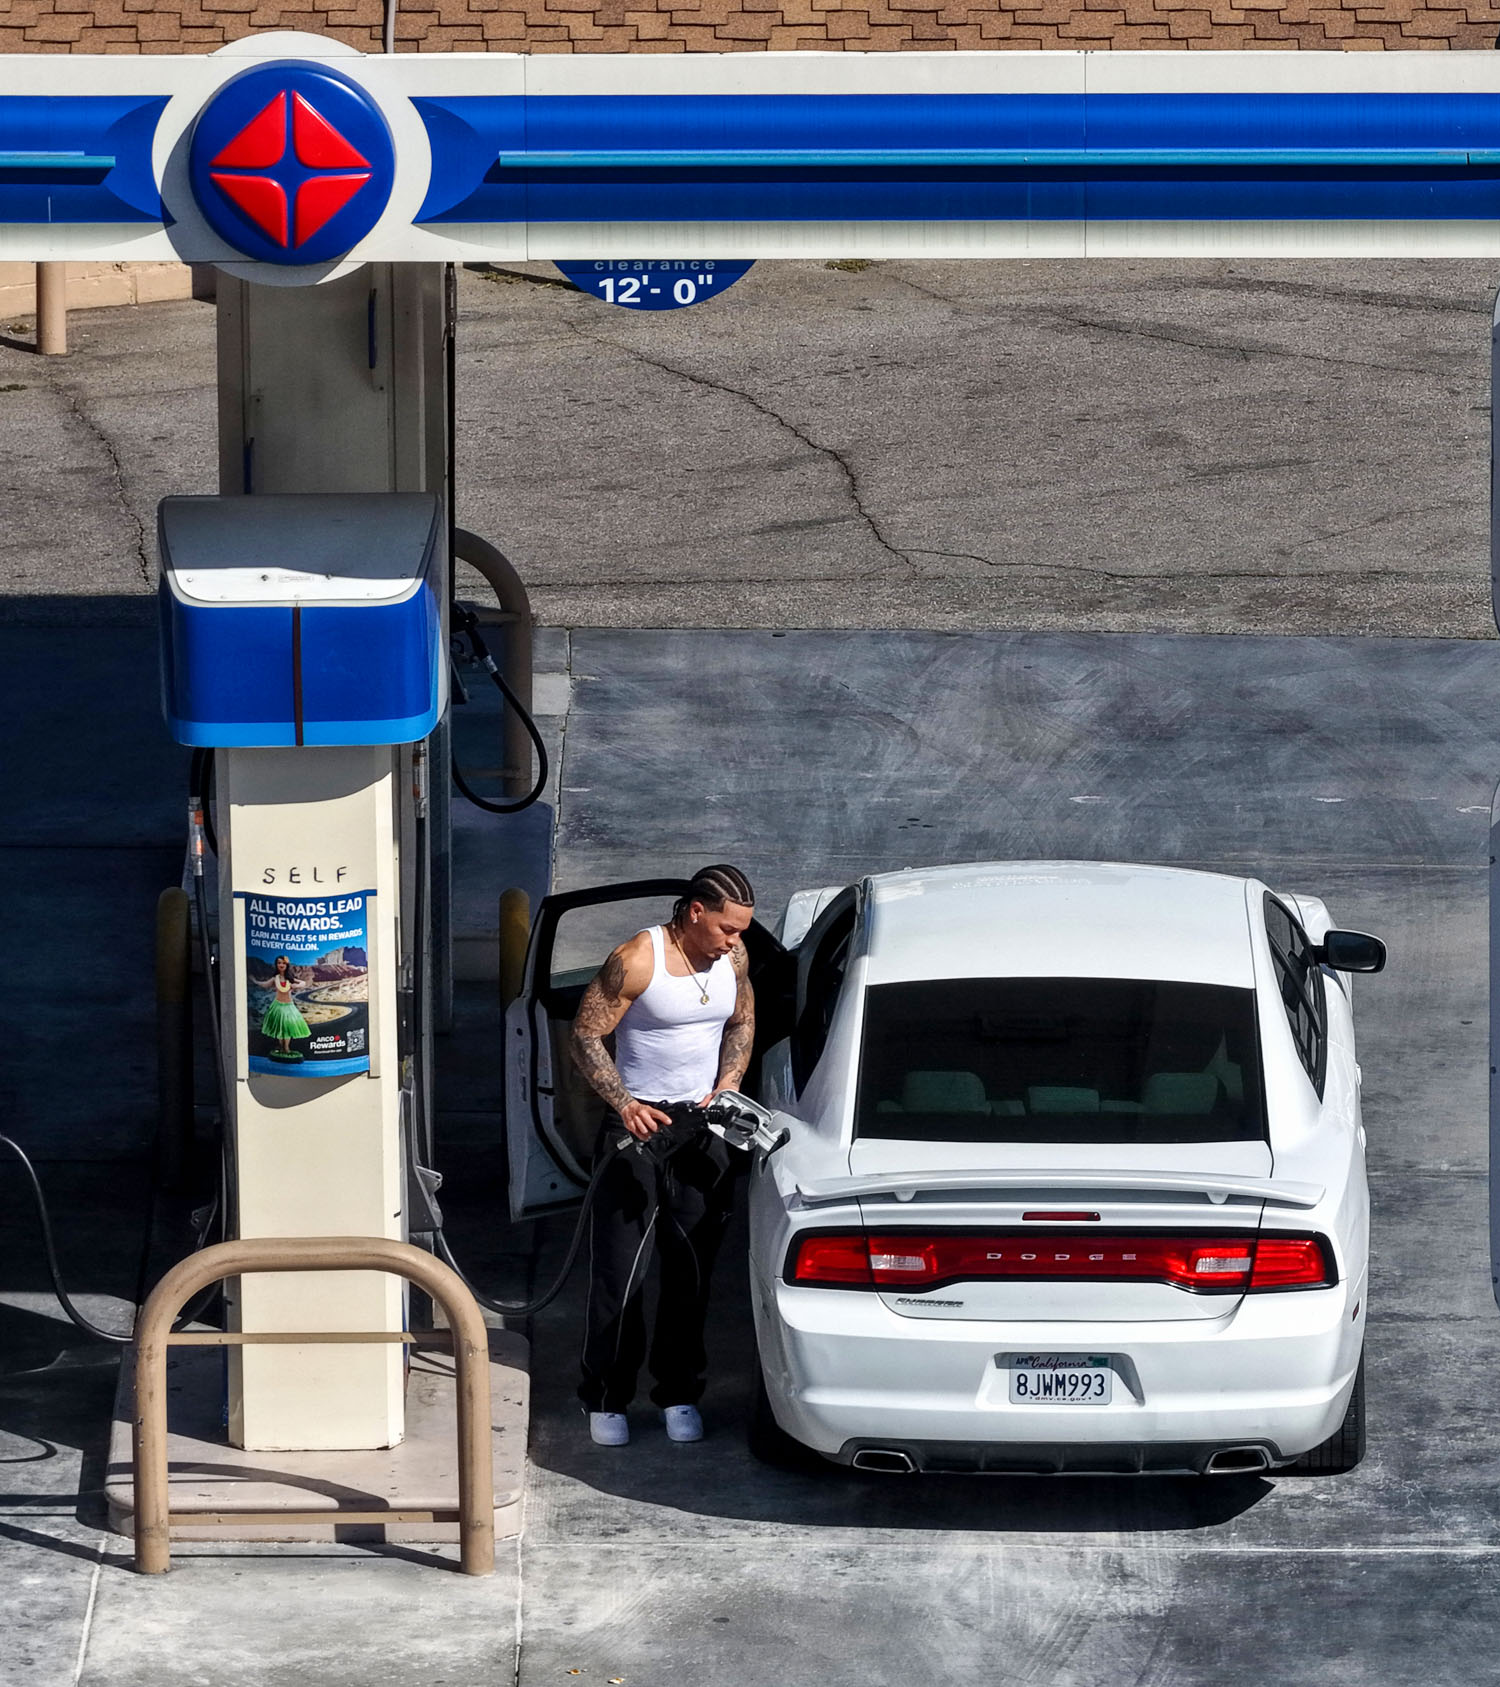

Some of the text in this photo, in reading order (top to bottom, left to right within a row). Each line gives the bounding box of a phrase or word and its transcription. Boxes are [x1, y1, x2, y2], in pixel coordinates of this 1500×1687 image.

[594, 260, 715, 271] clearance
[262, 866, 348, 884] SELF
[250, 897, 362, 916] ALL ROADS LEAD
[250, 914, 343, 931] TO REWARDS.
[251, 930, 270, 939] EARN
[281, 934, 305, 942] LEAST
[319, 933, 327, 941] IN
[328, 928, 362, 941] REWARDS
[251, 939, 319, 951] ON EVERY GALLON.
[310, 1040, 346, 1050] Rewards
[986, 1253, 1136, 1261] DODGE
[1031, 1356, 1089, 1371] California
[1016, 1373, 1105, 1397] 8JWM993
